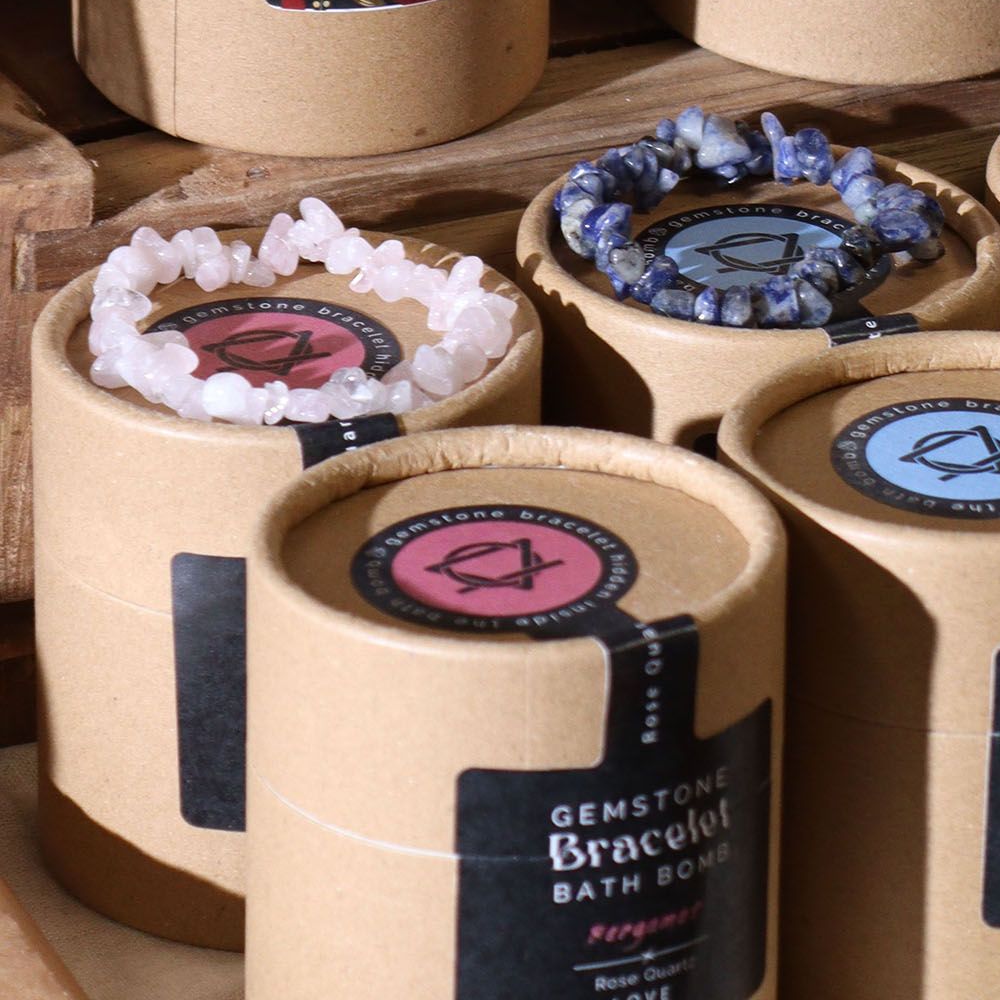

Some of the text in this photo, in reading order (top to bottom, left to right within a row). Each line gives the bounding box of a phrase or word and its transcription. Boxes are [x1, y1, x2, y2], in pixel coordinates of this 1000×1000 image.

[669, 205, 783, 229] gemstone
[183, 300, 305, 324] gemstone
[319, 306, 390, 352] bracelet
[850, 400, 951, 440] gemstone
[951, 503, 996, 514] the
[385, 509, 506, 547] gemstone
[519, 509, 617, 552] bracelet
[596, 552, 629, 600] hidden
[515, 600, 598, 628] inside
[551, 767, 730, 828] GEMSTONE
[548, 798, 732, 872] Bracelet
[552, 844, 731, 904] BATH BOMB
[594, 973, 639, 992] Rose
